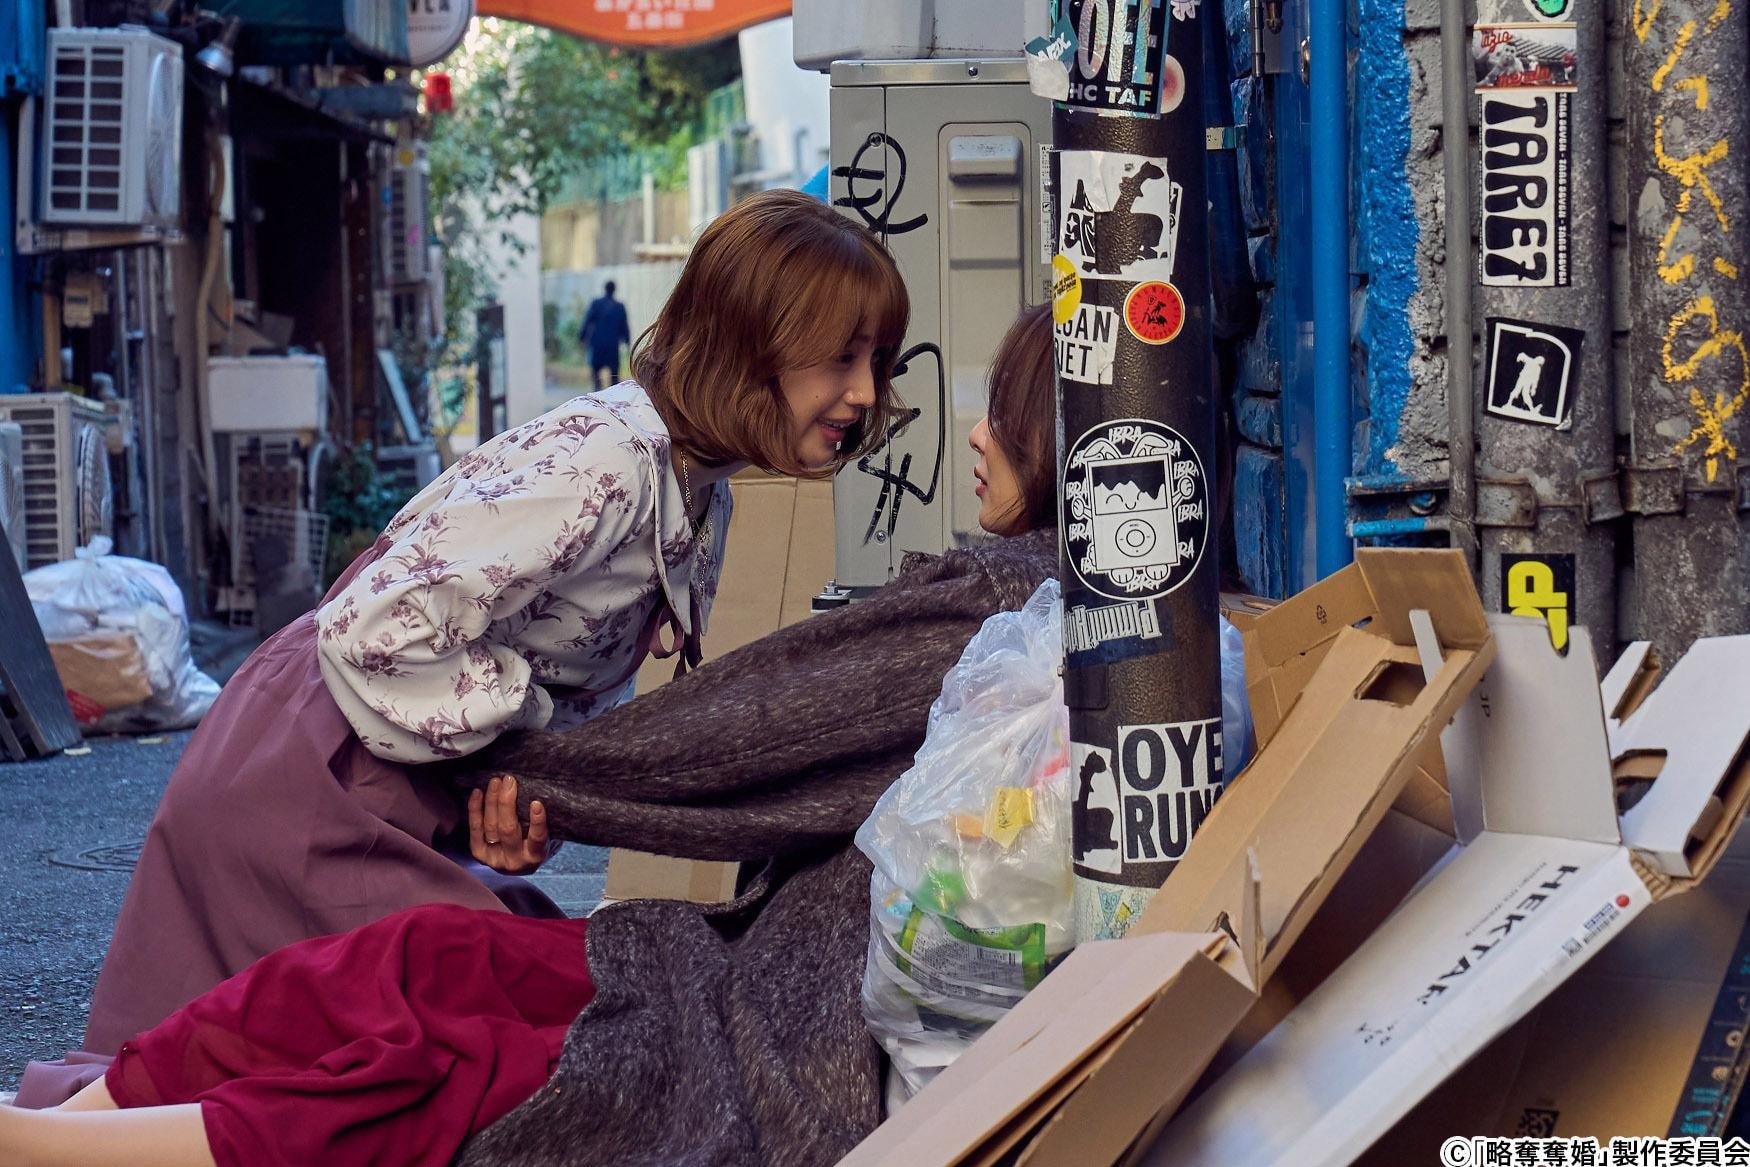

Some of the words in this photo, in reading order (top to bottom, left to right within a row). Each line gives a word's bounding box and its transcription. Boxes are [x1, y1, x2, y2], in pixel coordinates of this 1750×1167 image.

[1105, 86, 1152, 107] TAF
[1108, 426, 1142, 444] IBRA
[1122, 722, 1223, 791] OYE
[1124, 786, 1223, 859] RUN
